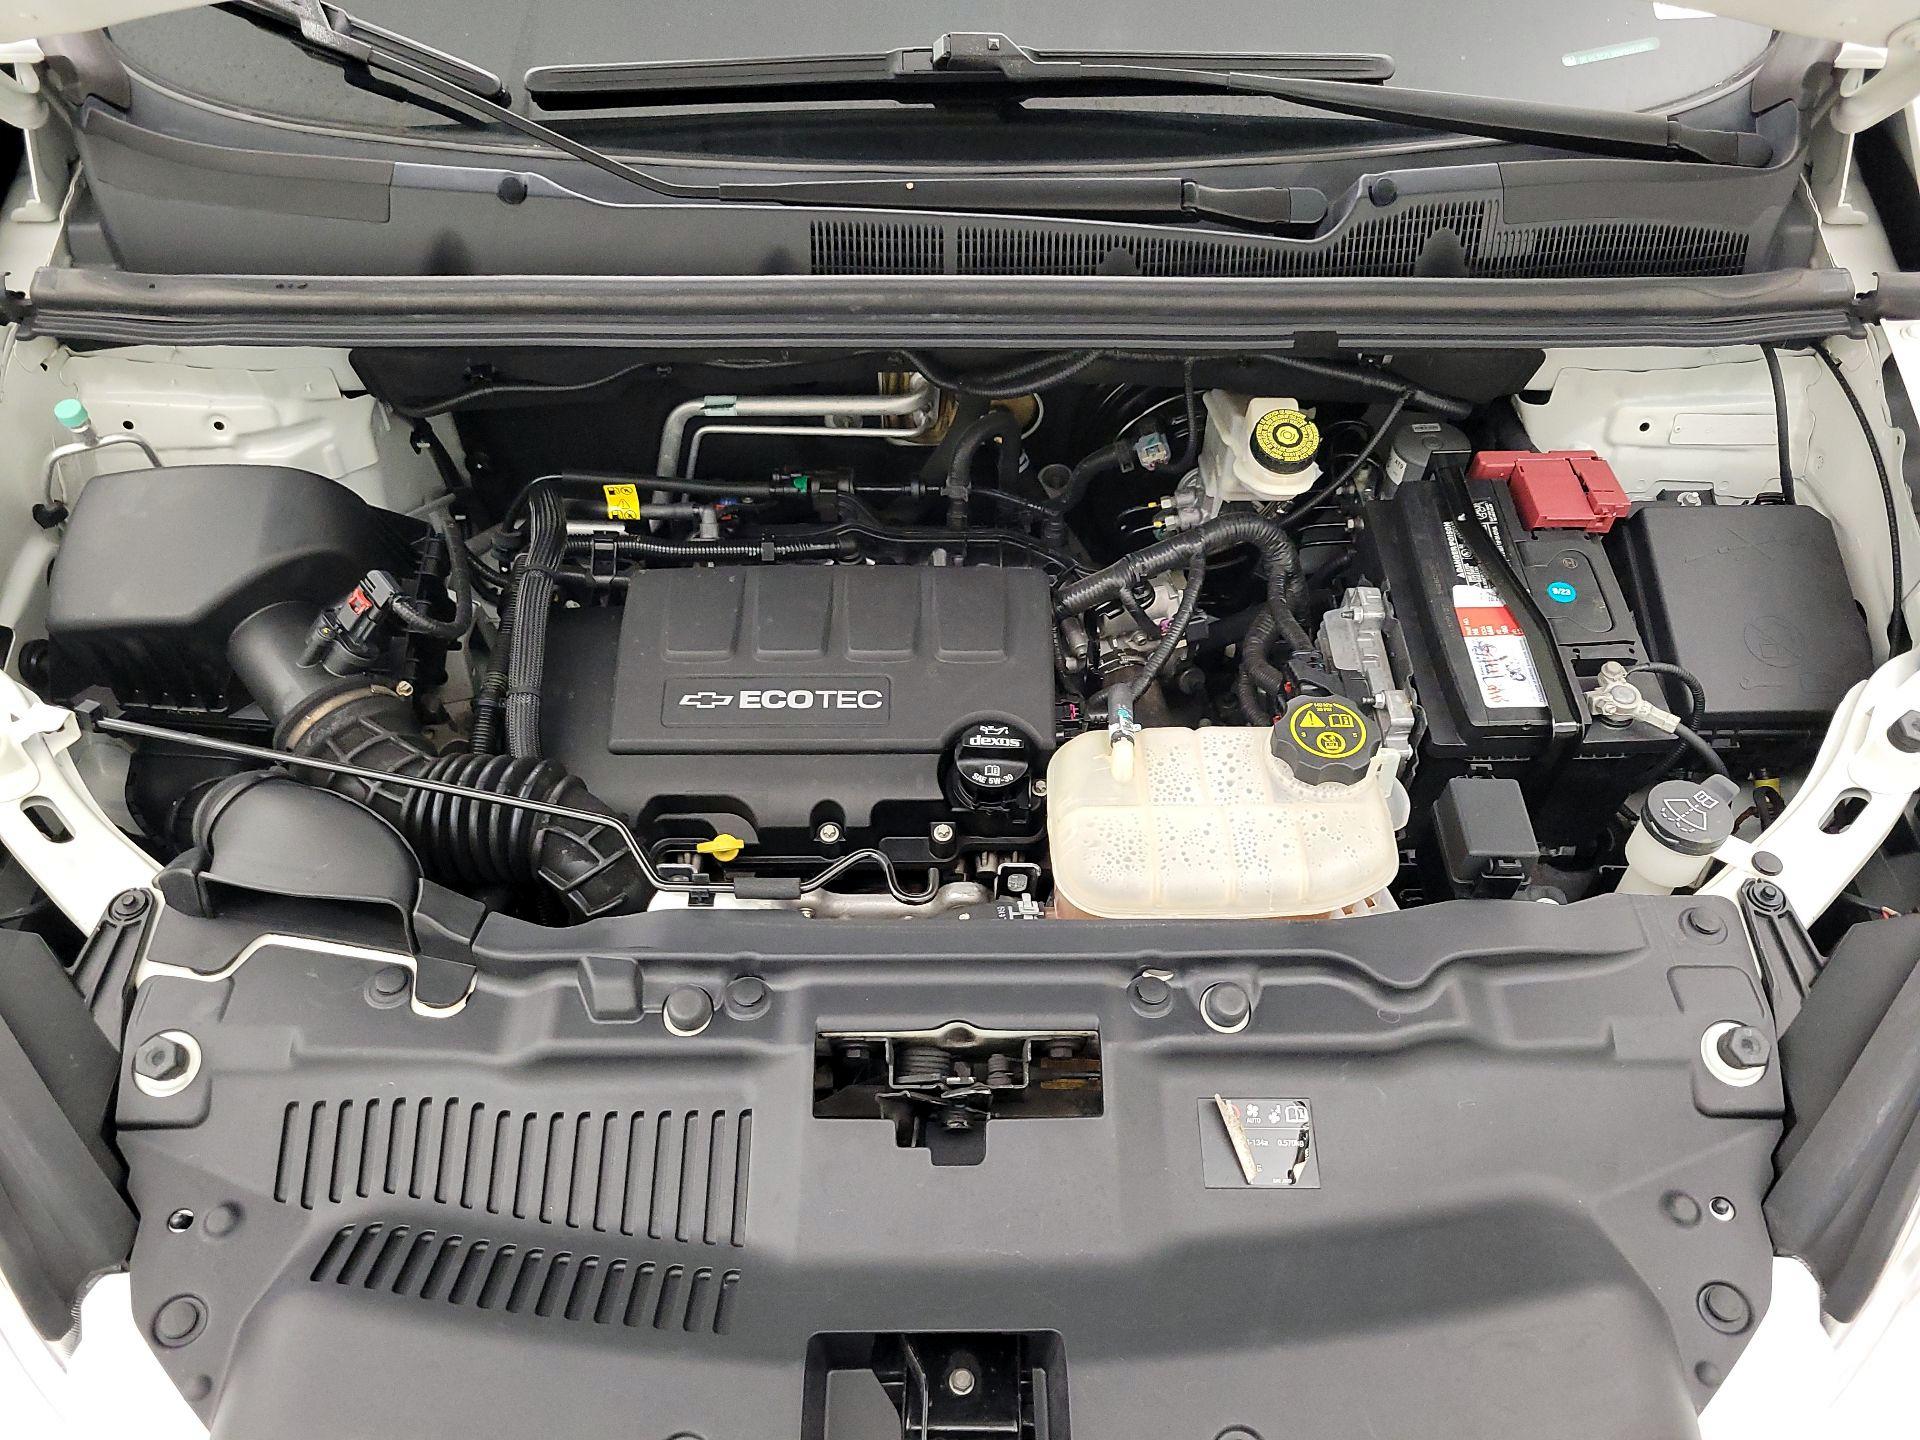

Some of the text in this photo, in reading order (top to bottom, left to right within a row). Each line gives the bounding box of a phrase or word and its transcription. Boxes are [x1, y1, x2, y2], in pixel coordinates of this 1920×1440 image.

[739, 690, 883, 709] ECOTEC
[970, 735, 1022, 747] dexos
[972, 773, 1013, 785] SAE 5W-30
